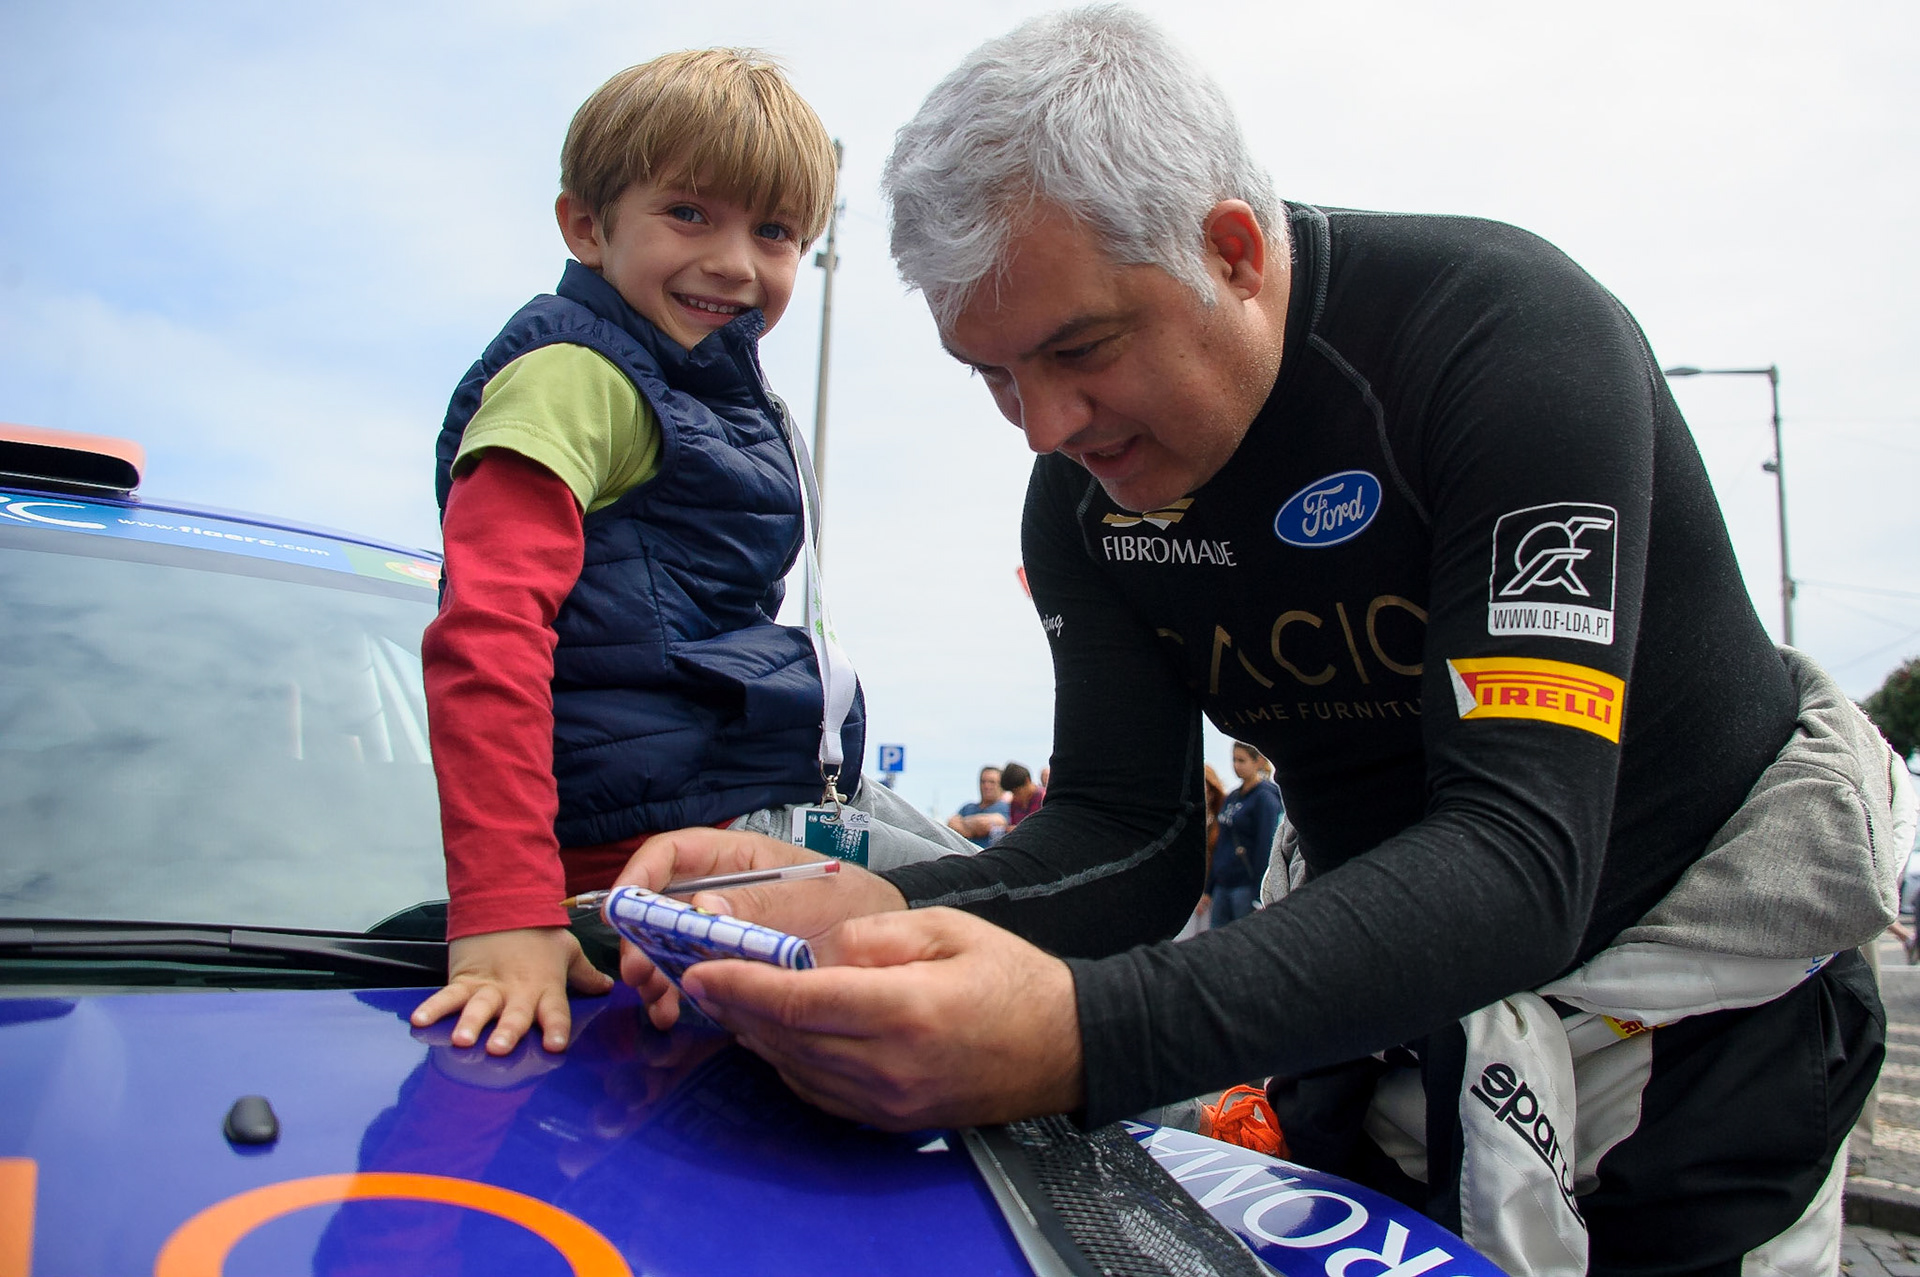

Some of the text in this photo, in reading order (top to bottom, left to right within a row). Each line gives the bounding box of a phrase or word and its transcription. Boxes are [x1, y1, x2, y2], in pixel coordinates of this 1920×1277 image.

[1301, 483, 1365, 537] Ford
[117, 518, 331, 556] www.fiaerc.com
[1102, 535, 1238, 567] FIBROMADE
[1156, 594, 1429, 695] ACIO
[1493, 608, 1611, 639] WWW.QF-LDA.PT
[1220, 703, 1290, 730] IME
[1460, 671, 1615, 725] PIRELLI
[882, 746, 901, 771] P
[1472, 1062, 1581, 1214] sparc
[1118, 1118, 1474, 1277] ROMA
